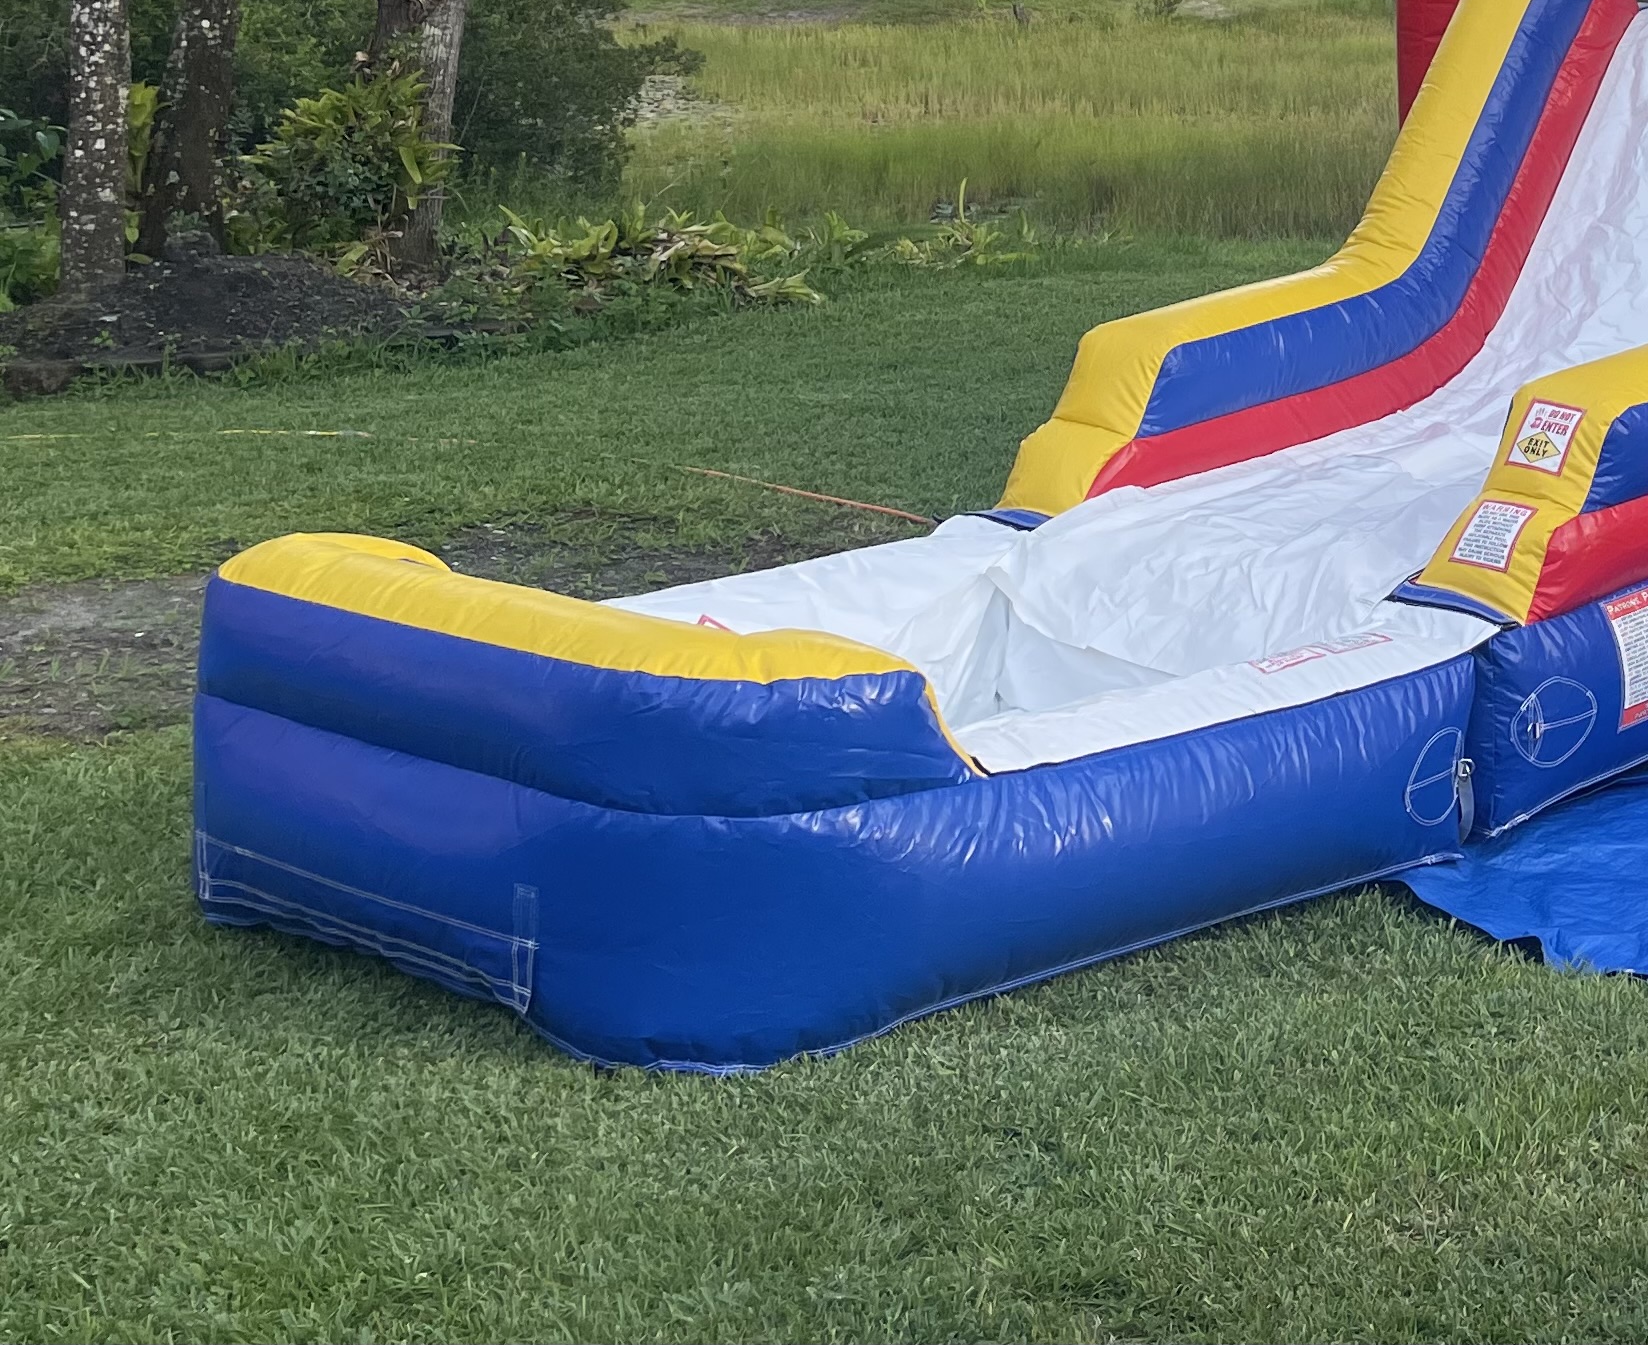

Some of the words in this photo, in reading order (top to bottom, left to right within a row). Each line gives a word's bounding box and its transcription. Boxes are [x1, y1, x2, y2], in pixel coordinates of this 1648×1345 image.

[1548, 410, 1559, 418] DO
[1560, 412, 1576, 422] NOT
[1541, 420, 1569, 436] ENTER
[1528, 438, 1549, 448] EXIT
[1524, 446, 1548, 457] ONLY
[1483, 504, 1527, 516] WARNING
